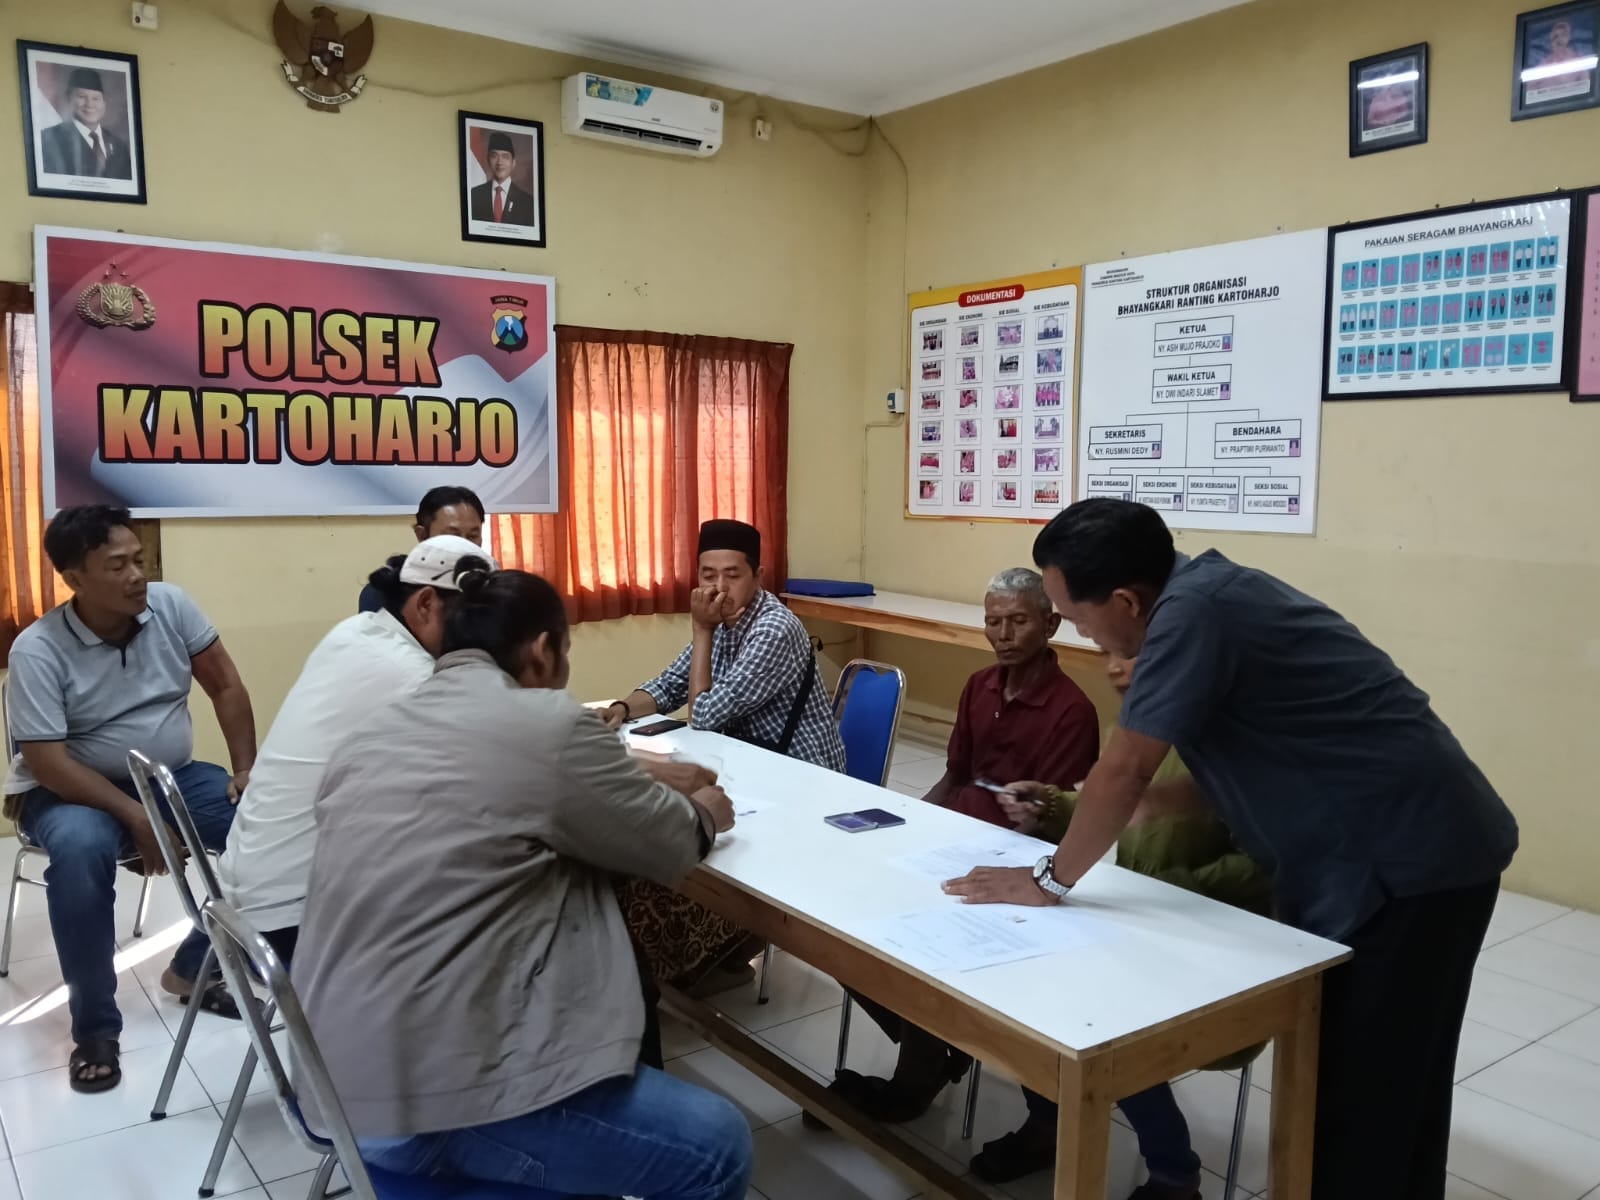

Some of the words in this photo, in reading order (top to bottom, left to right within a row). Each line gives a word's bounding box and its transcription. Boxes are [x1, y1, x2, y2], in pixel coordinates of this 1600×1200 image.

[1364, 235, 1405, 248] PAKAIAN
[1407, 227, 1456, 241] SERAGAM
[1458, 216, 1533, 234] BHAYANGKARI
[1146, 283, 1190, 300] STRUKTUR
[1193, 276, 1247, 293] ORGANISASI
[966, 289, 1016, 304] DOKUMENTASI
[1117, 298, 1175, 316] BHAYANGKARI
[1177, 292, 1215, 308] RANTING
[1217, 286, 1280, 303] KARTOHARJO
[1179, 324, 1207, 335] KETUA
[199, 301, 441, 387] POLSEK
[1167, 373, 1190, 382] WAKIL
[1191, 371, 1216, 381] KETUA
[1196, 386, 1219, 397] SLAMET
[98, 384, 518, 467] KARTOHARJO
[1232, 425, 1281, 436] BENDAHARA
[1104, 430, 1146, 439] SEKRETARIS
[1105, 447, 1131, 455] RUSMINI
[1132, 446, 1149, 455] DEDY
